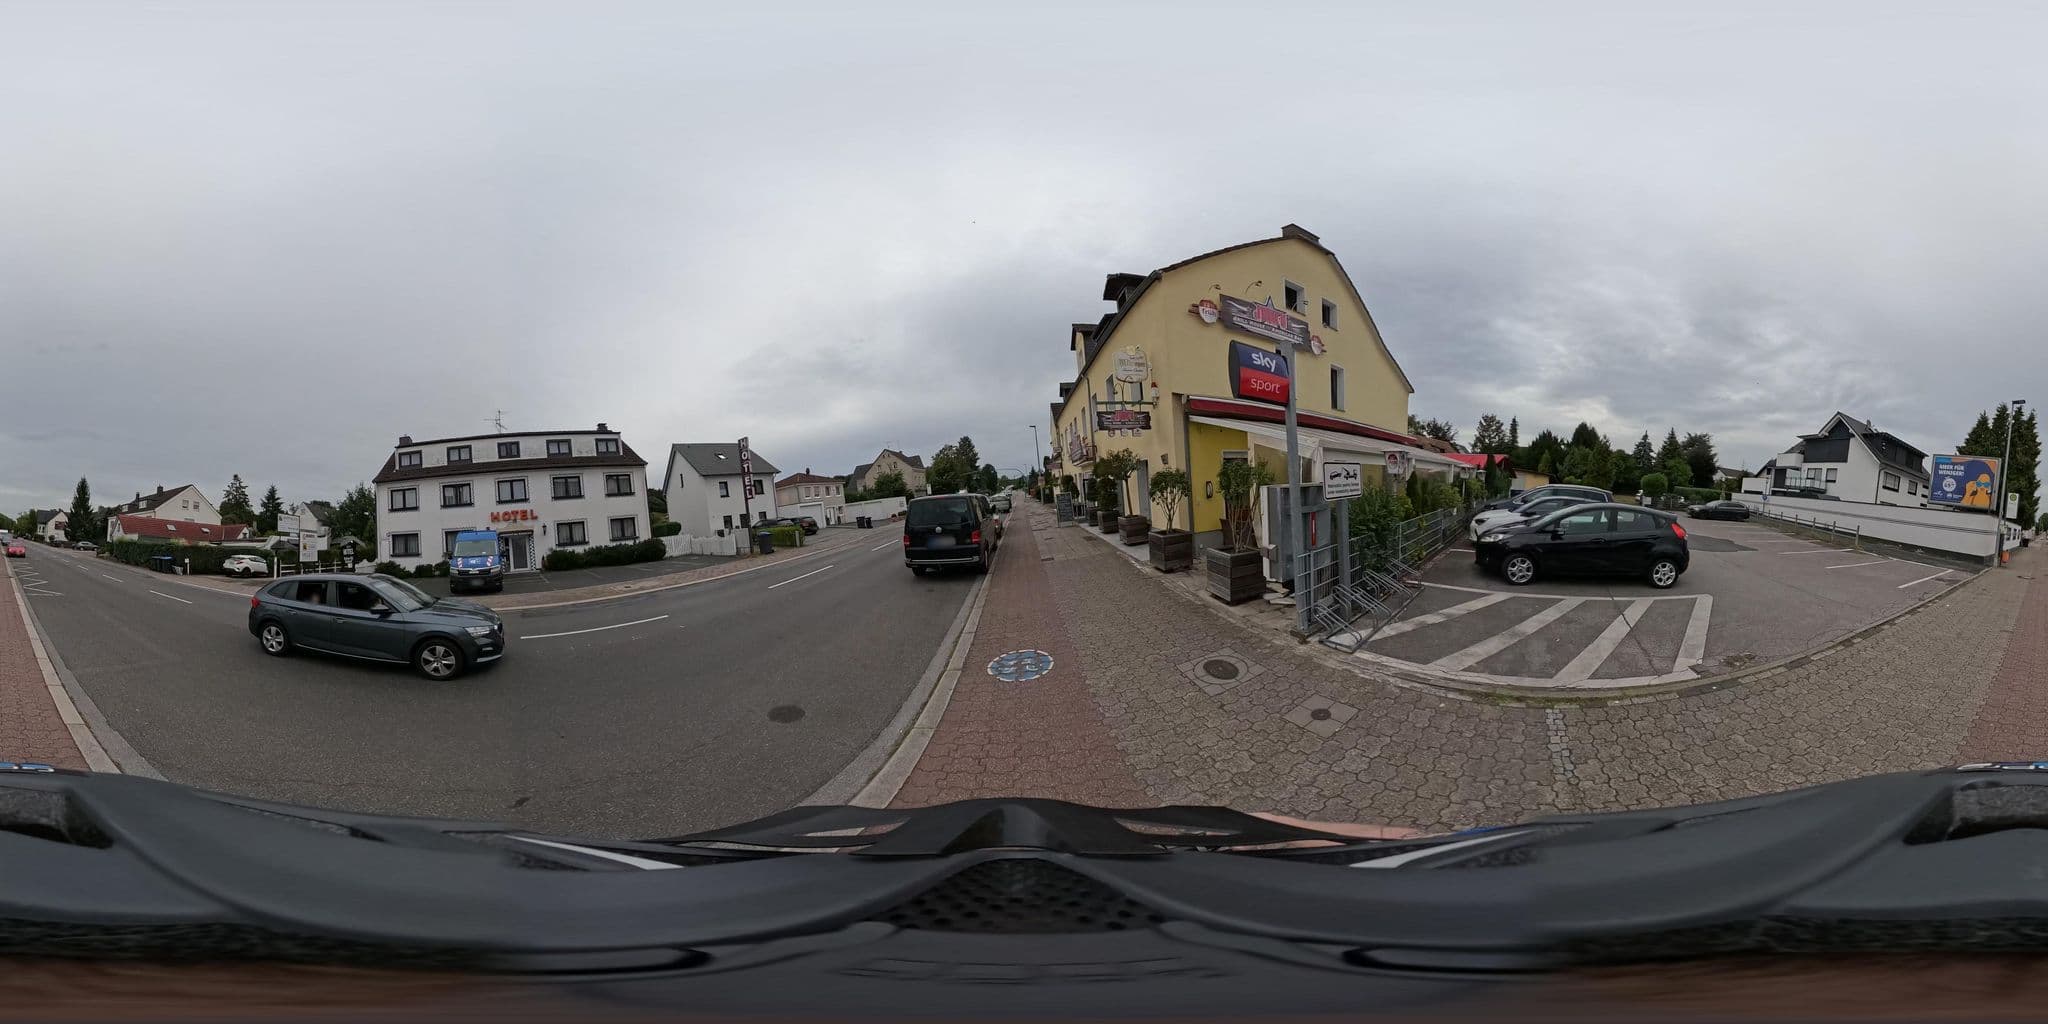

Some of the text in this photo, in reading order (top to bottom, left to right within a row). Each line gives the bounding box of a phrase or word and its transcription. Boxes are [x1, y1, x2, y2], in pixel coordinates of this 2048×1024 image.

[1251, 352, 1276, 372] sky
[1250, 378, 1281, 394] sport
[740, 439, 752, 498] HOTEL
[490, 509, 538, 522] HOTEL
